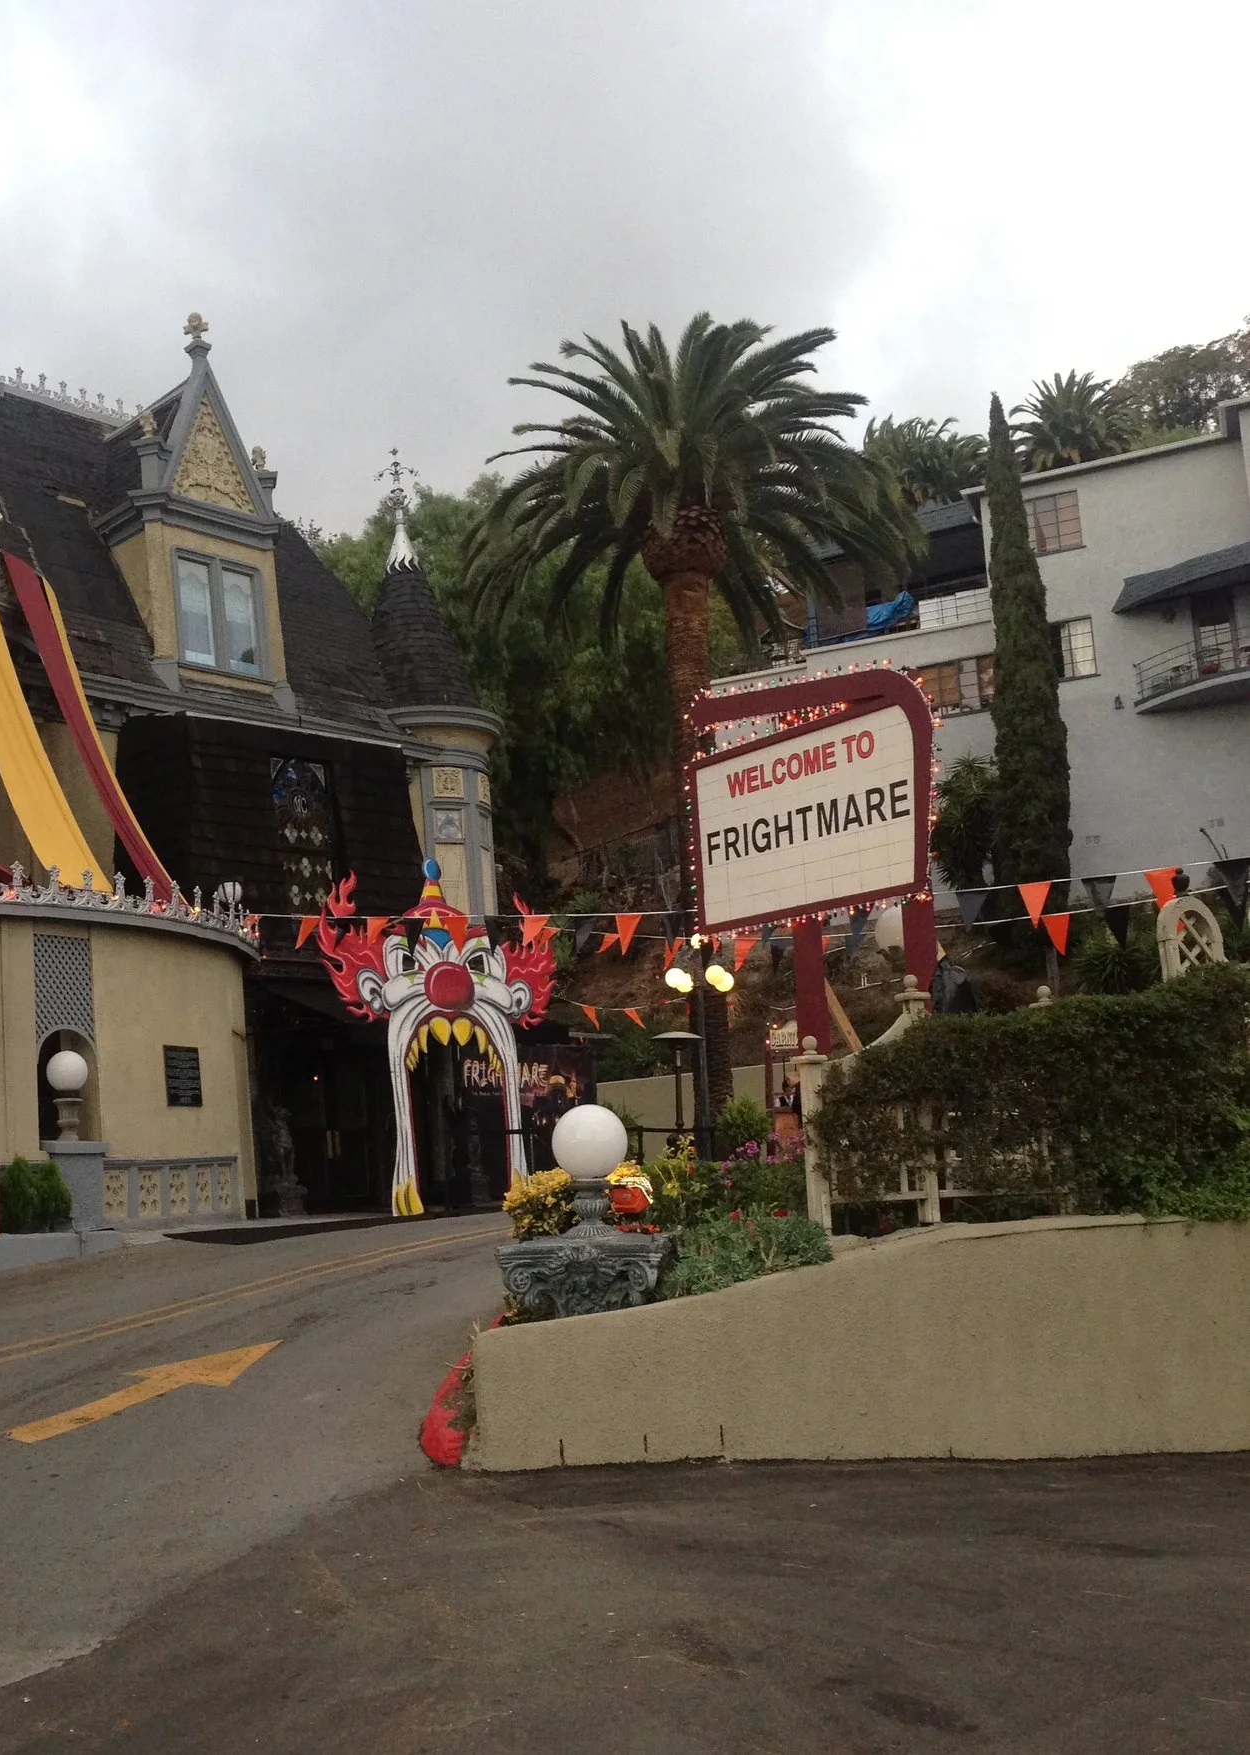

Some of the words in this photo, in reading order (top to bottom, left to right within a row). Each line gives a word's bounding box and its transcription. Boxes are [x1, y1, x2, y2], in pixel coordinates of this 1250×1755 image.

[726, 741, 837, 798] WELCOME
[841, 730, 875, 763] TO
[706, 779, 911, 866] FRIGHTMARE
[463, 1058, 549, 1088] FRIGHARE
